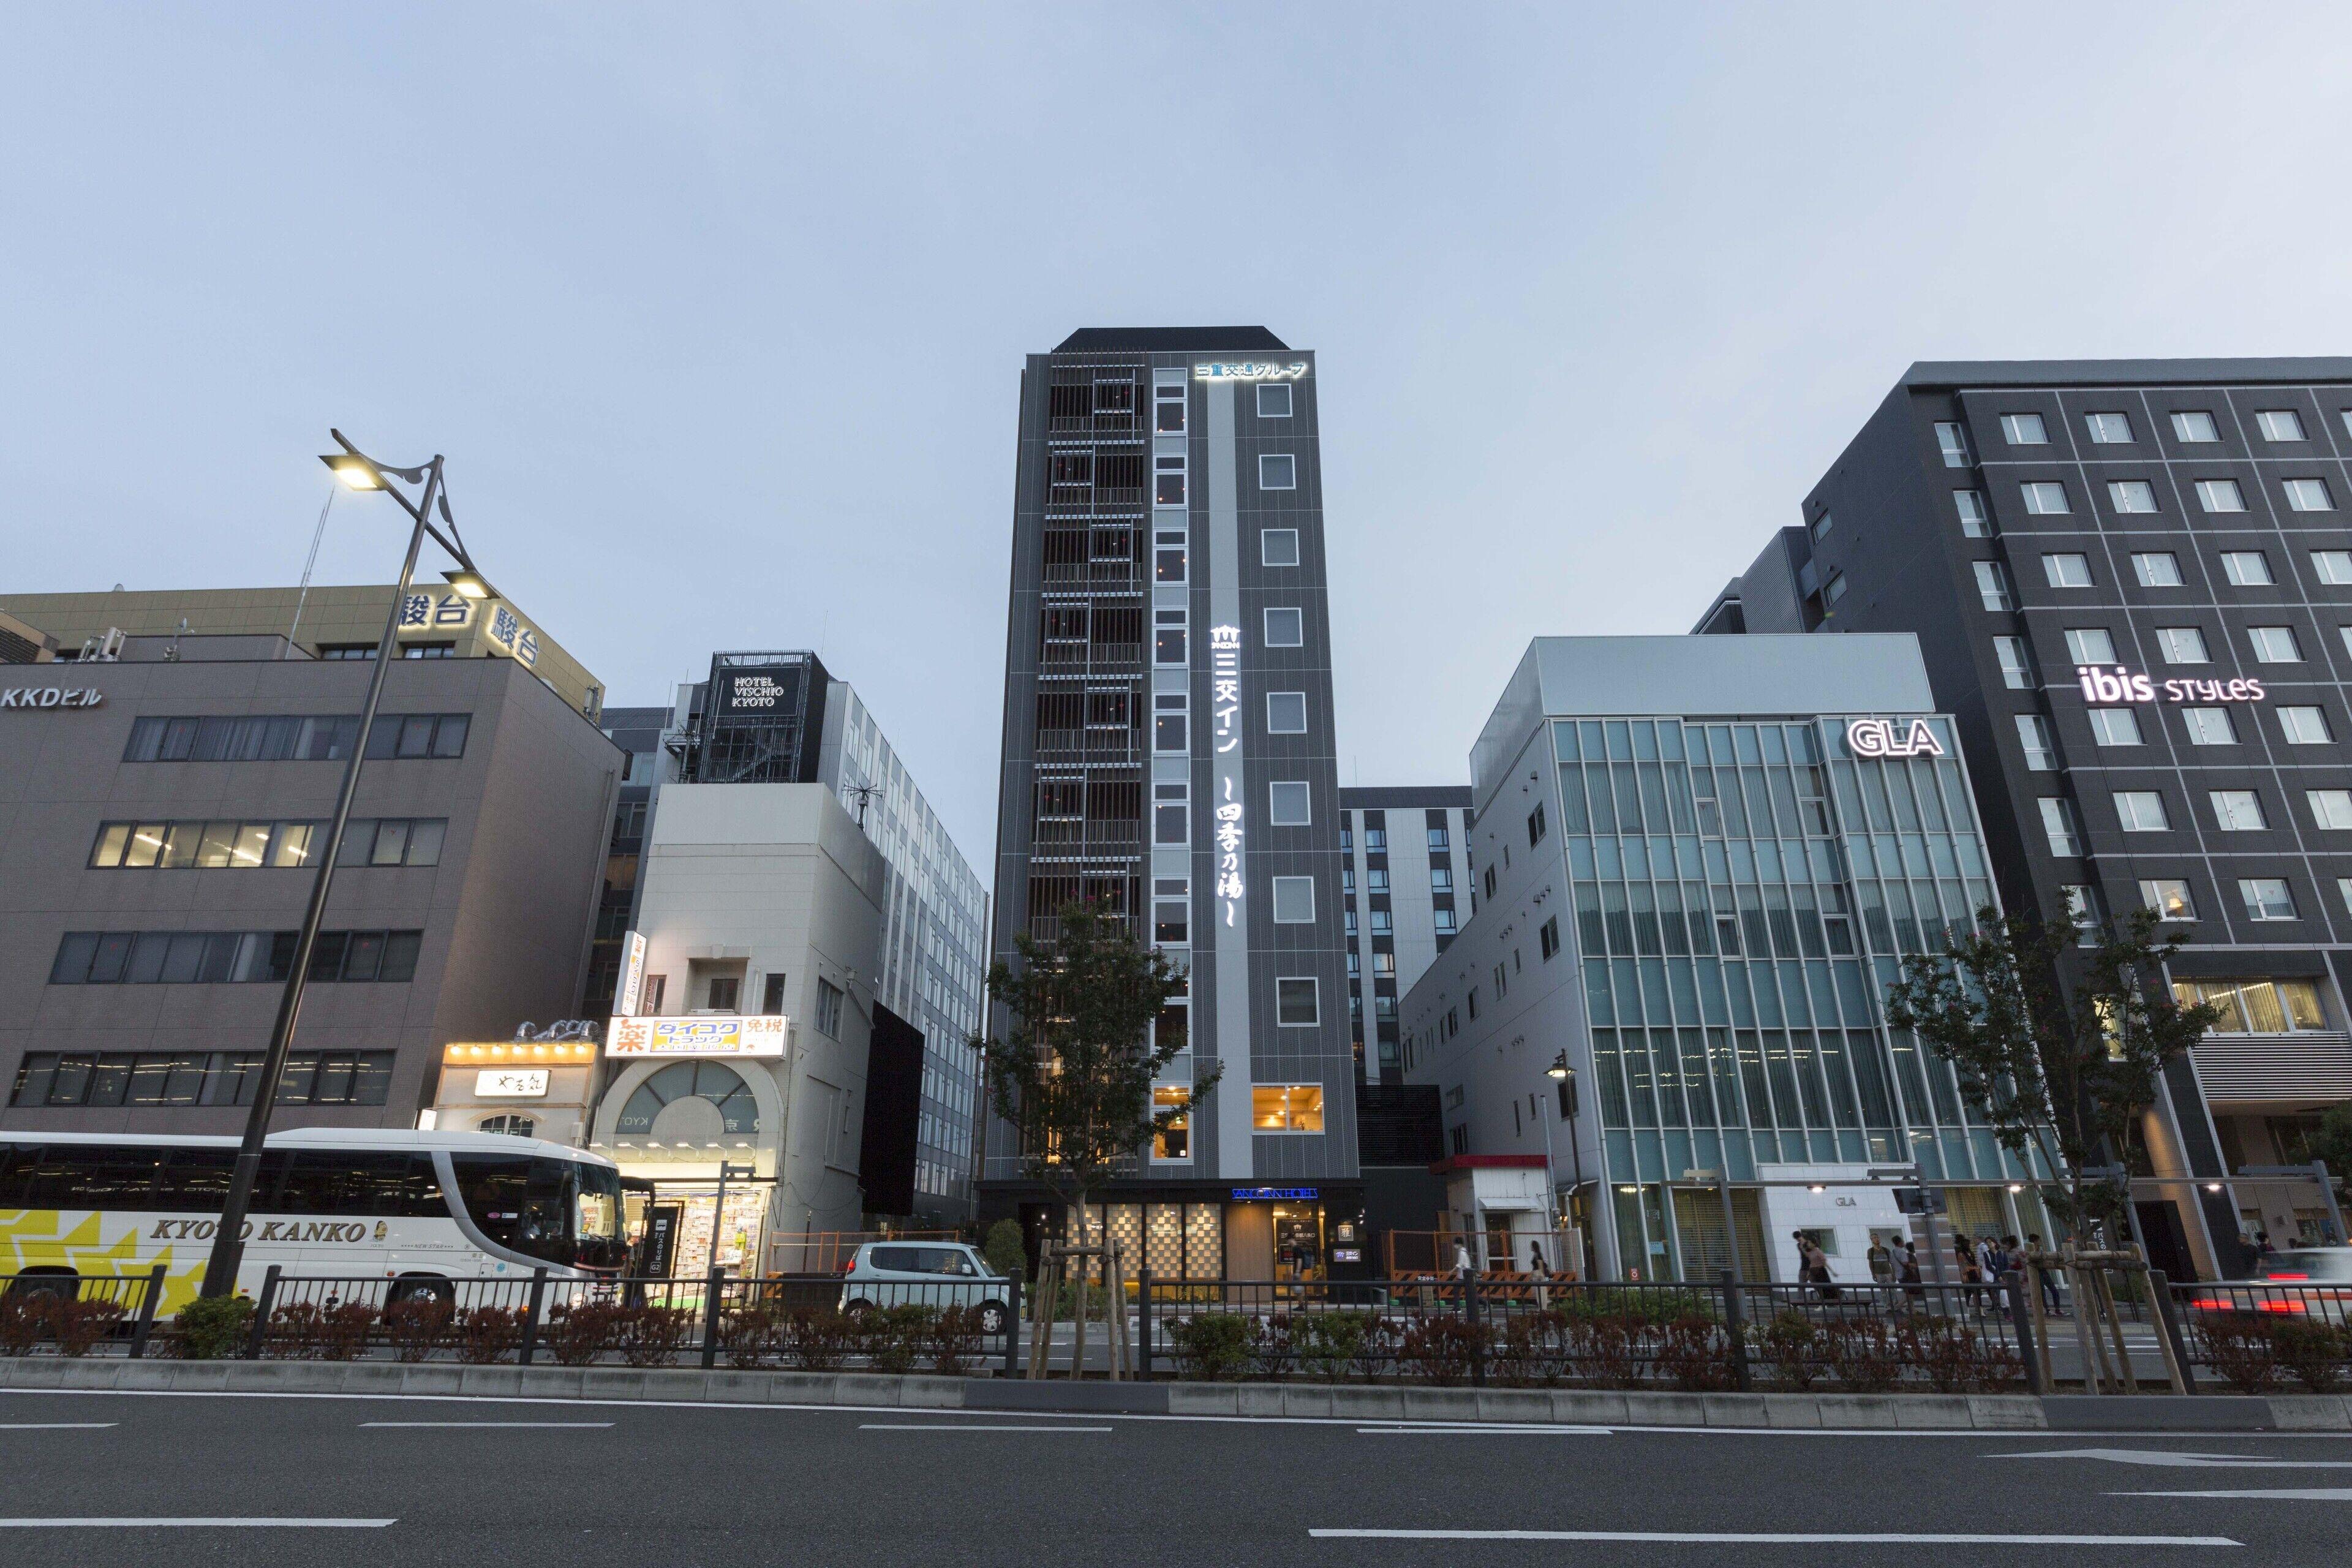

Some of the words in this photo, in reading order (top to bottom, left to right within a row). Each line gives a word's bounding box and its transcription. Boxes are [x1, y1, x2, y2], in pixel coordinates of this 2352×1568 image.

[1196, 363, 1305, 377] 三重交通グループ
[491, 606, 539, 666] 駿台
[734, 677, 774, 687] HOTEL
[2077, 667, 2154, 702] ibis
[0, 688, 102, 707] KKDビル
[734, 686, 784, 696] VISCHIO
[731, 696, 775, 707] KYOTO
[1215, 653, 1238, 753] 三交イン
[1847, 719, 1944, 756] GLA
[658, 1023, 737, 1035] ダイコク
[747, 1019, 782, 1033] 免税
[616, 1019, 647, 1052] 薬
[1836, 1197, 1856, 1206] GLA
[149, 1219, 253, 1240] KYOO
[257, 1221, 366, 1243] KANKO
